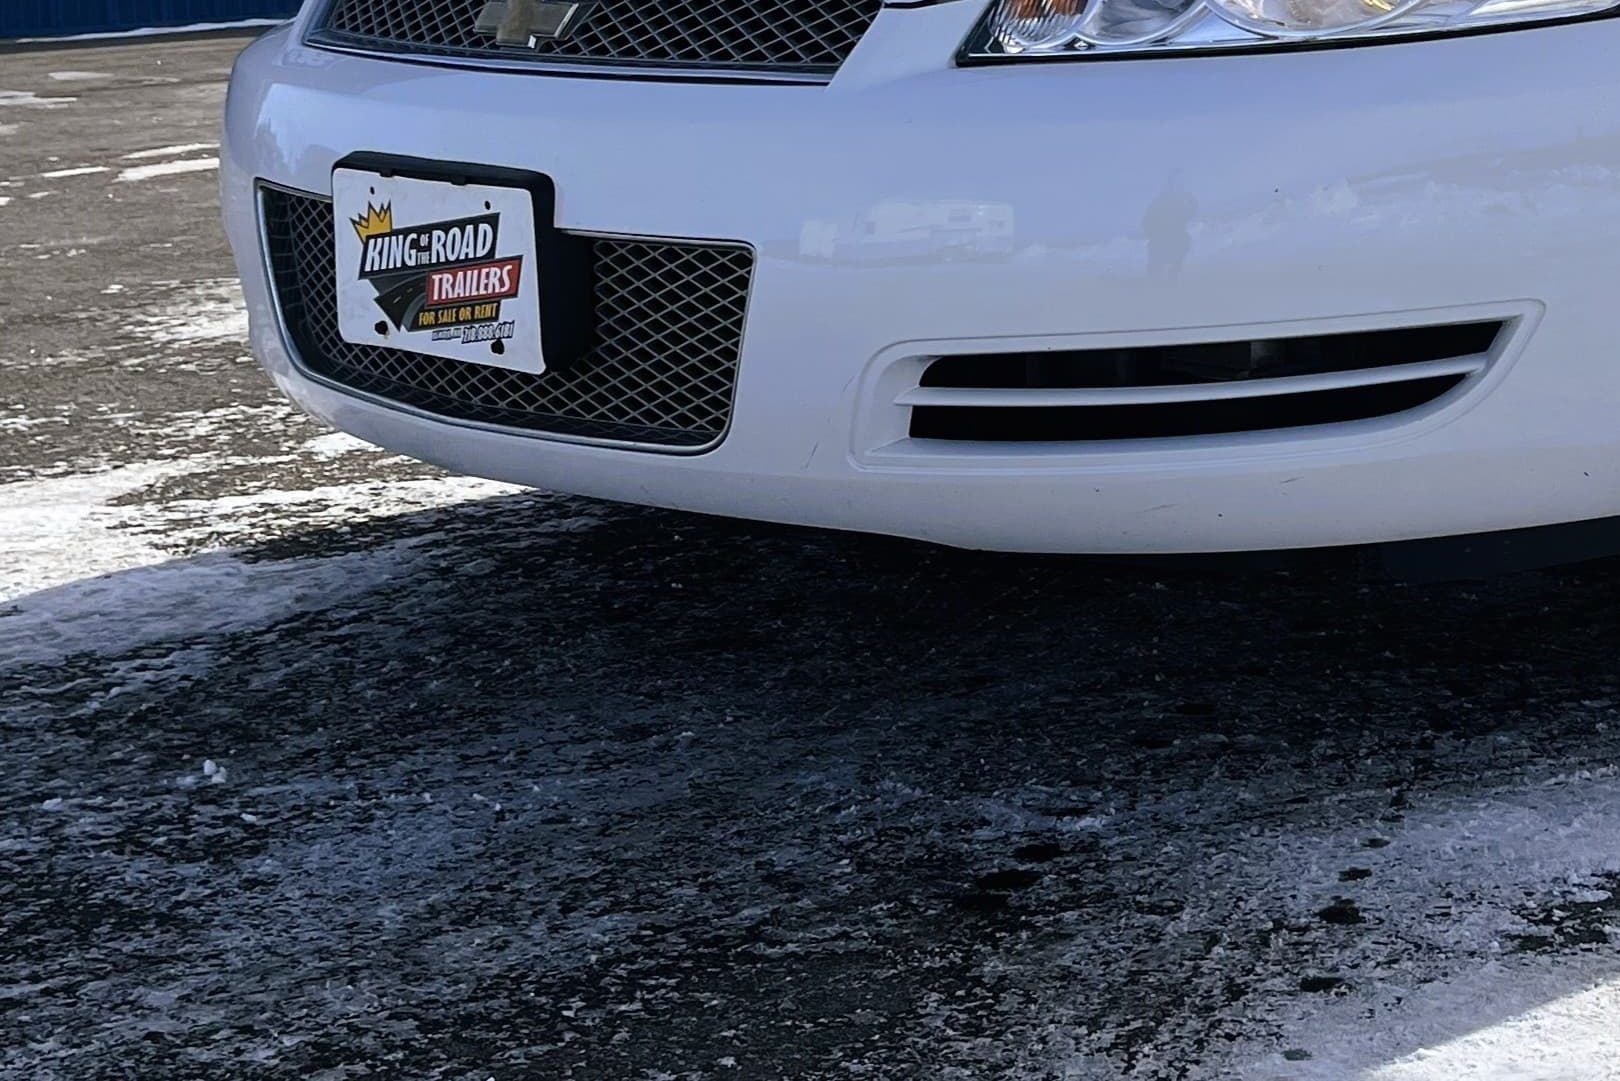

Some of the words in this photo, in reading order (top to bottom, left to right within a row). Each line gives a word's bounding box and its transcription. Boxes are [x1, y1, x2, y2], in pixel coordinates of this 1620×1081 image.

[365, 233, 418, 272] KING
[420, 234, 429, 247] OF
[431, 223, 493, 264] ROAD
[417, 251, 430, 265] THE
[432, 265, 513, 300] TRAILERS
[419, 311, 436, 326] FOR
[438, 308, 457, 324] SALE
[459, 306, 472, 321] OR
[474, 303, 498, 320] RENT
